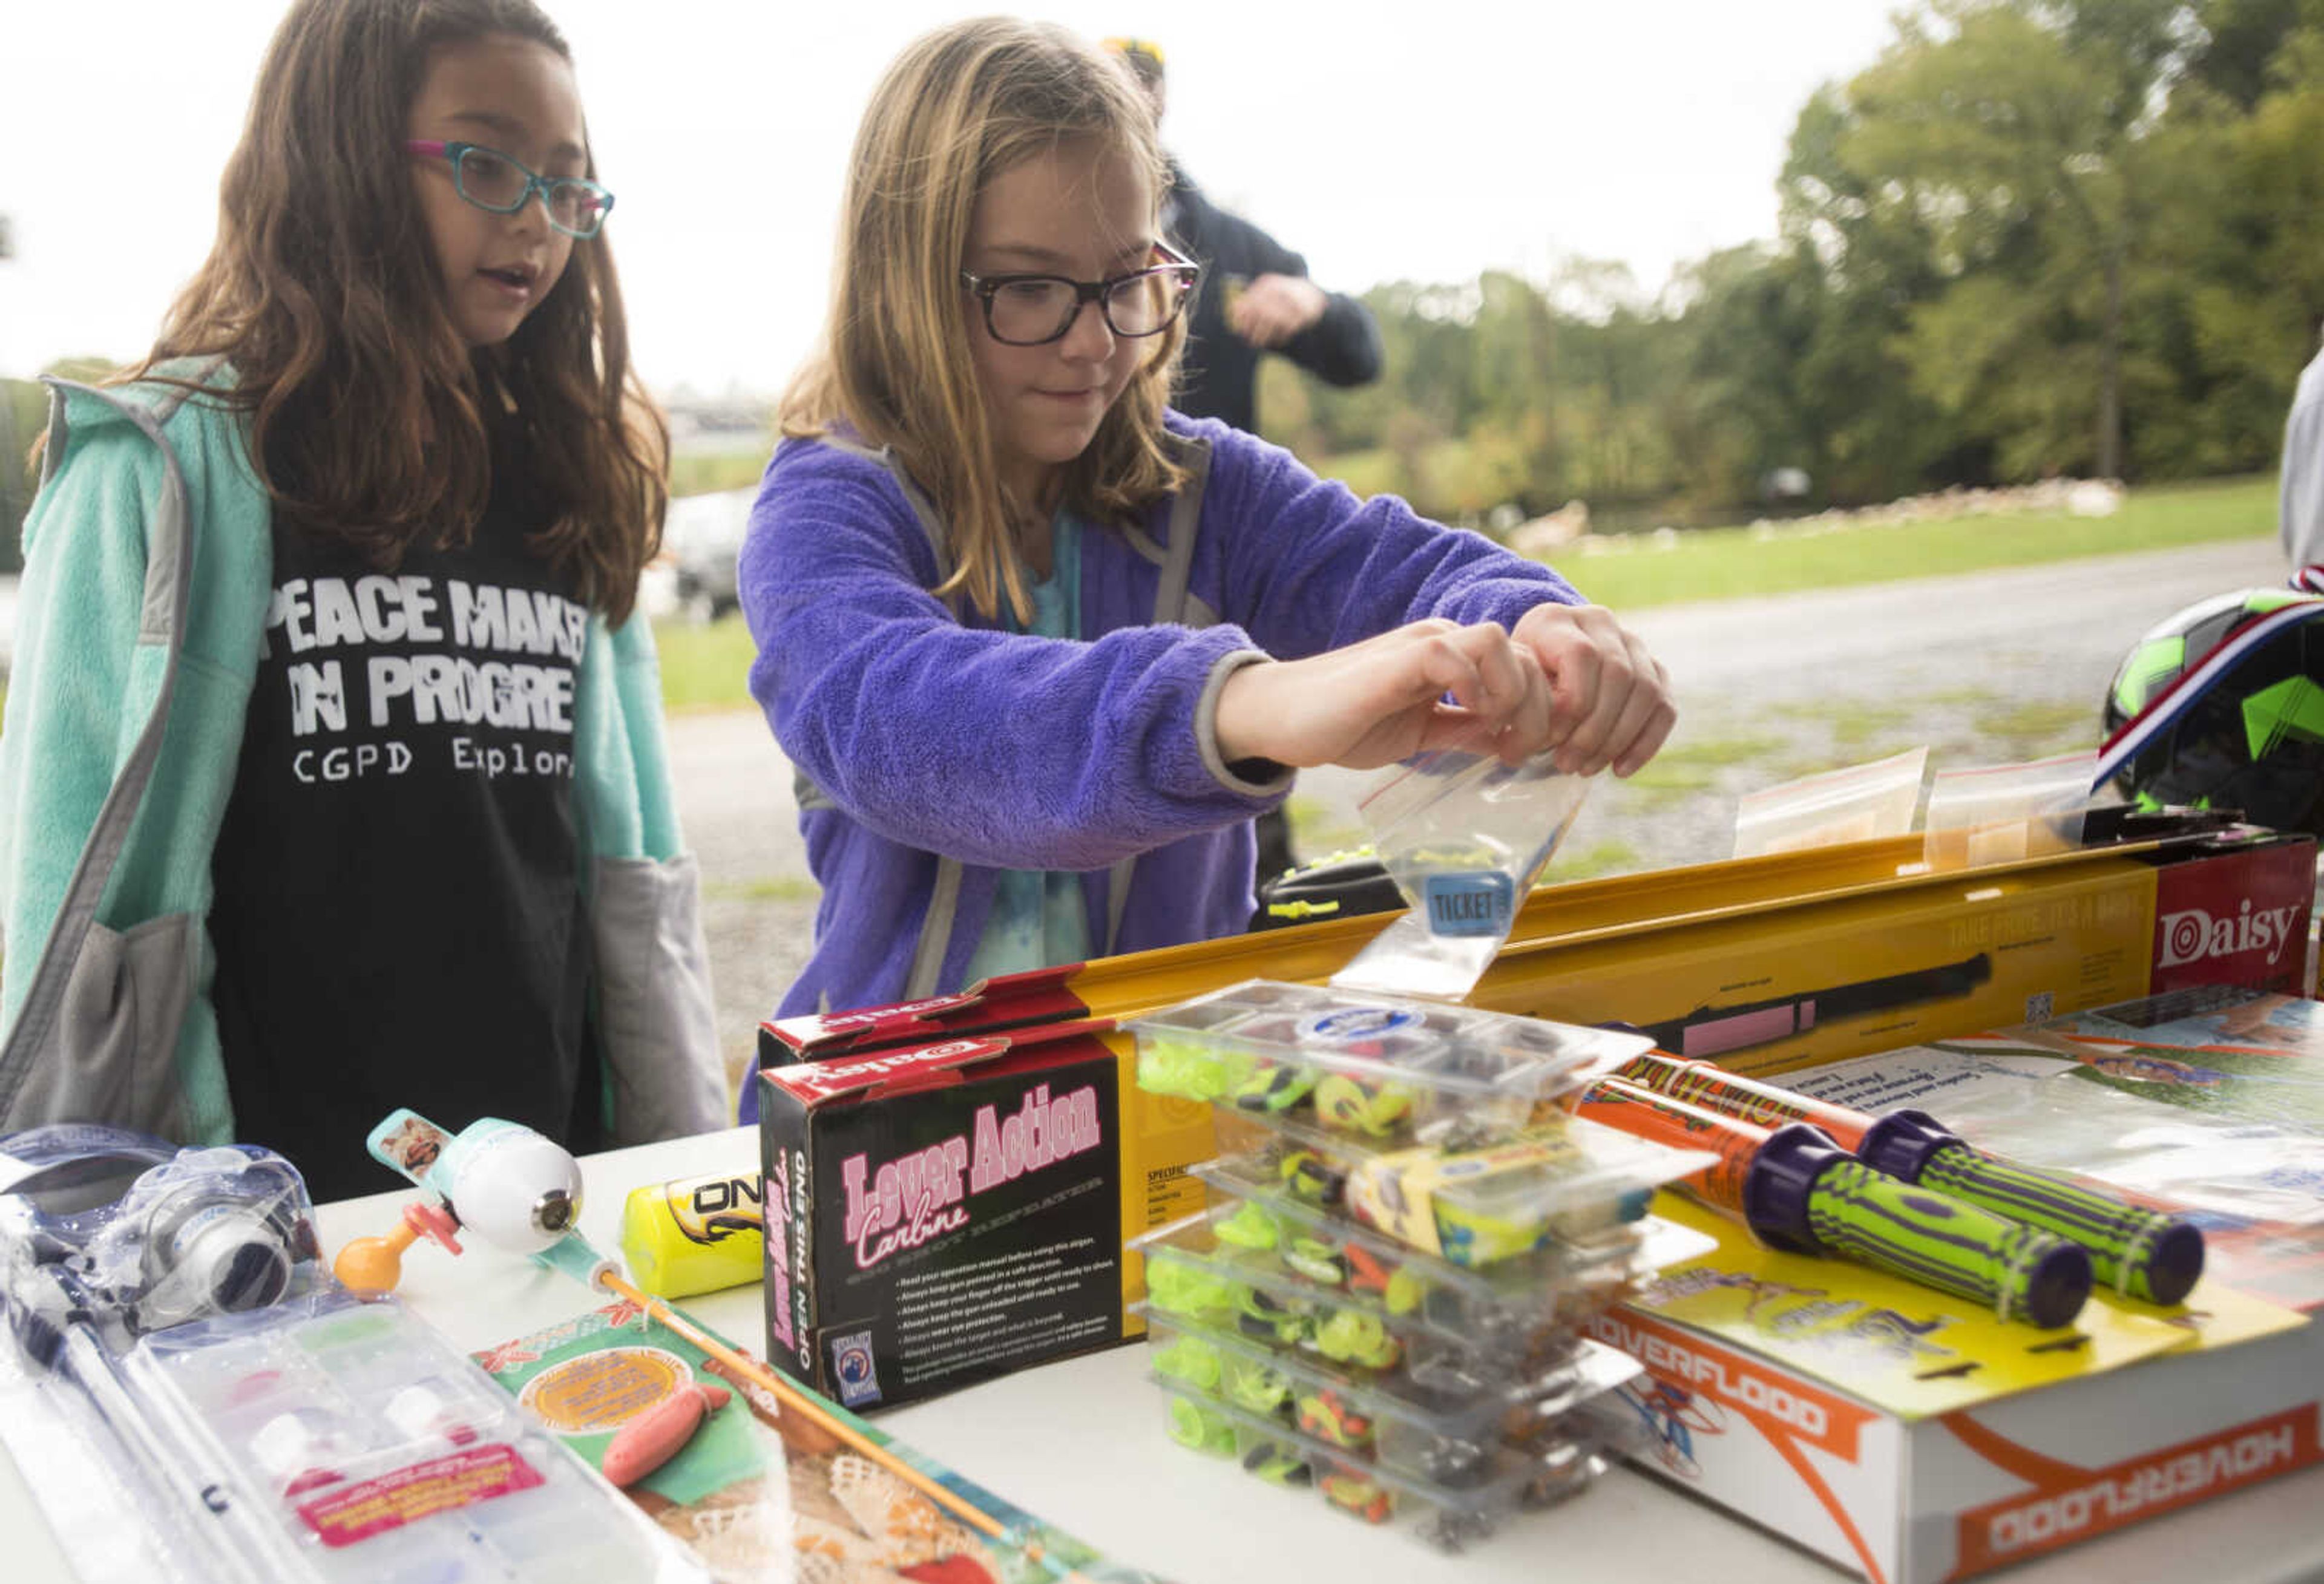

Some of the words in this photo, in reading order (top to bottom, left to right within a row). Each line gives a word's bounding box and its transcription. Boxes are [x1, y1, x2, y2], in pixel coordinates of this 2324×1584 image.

[260, 575, 442, 660] PEACE
[287, 659, 348, 736] IN
[293, 742, 413, 782] CGPD
[453, 738, 575, 779] Explor
[1432, 891, 1493, 923] TICKET
[2158, 898, 2300, 969] Daisy
[793, 1149, 806, 1214] END
[841, 1136, 968, 1243] Lever
[970, 1082, 1101, 1194] Action
[794, 1218, 807, 1285] THIS
[855, 1190, 971, 1270] Carbine
[797, 1289, 811, 1372] OPEN
[1988, 1424, 2294, 1554] HOVERFLOOD
